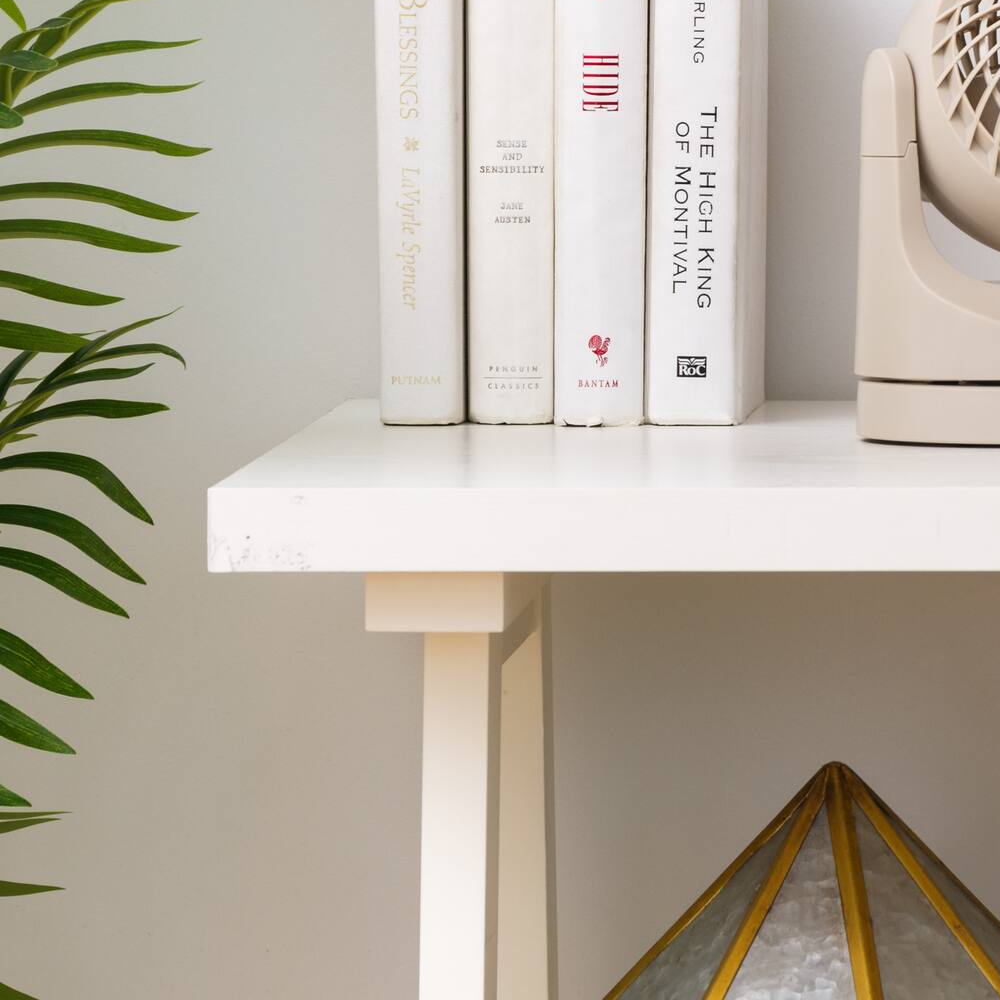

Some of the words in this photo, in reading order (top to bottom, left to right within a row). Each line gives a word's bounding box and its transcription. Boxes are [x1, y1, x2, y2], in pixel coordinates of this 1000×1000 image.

[582, 53, 620, 112] HIDE
[699, 106, 718, 158] THE
[675, 121, 690, 154] OF
[496, 139, 528, 149] SENSE
[502, 152, 523, 161] AND
[479, 165, 545, 174] SENSIBILITY
[500, 201, 524, 210] JANE
[698, 171, 717, 234] HIGH
[494, 215, 531, 224] AUSTEN
[672, 165, 692, 295] MONTIVAL
[395, 241, 421, 311] Spencer
[696, 247, 715, 309] KING
[488, 365, 538, 373] PENGUIN
[391, 375, 442, 385] PUTNAM
[578, 379, 619, 388] BANTAM
[487, 382, 540, 390] CLASSICS
